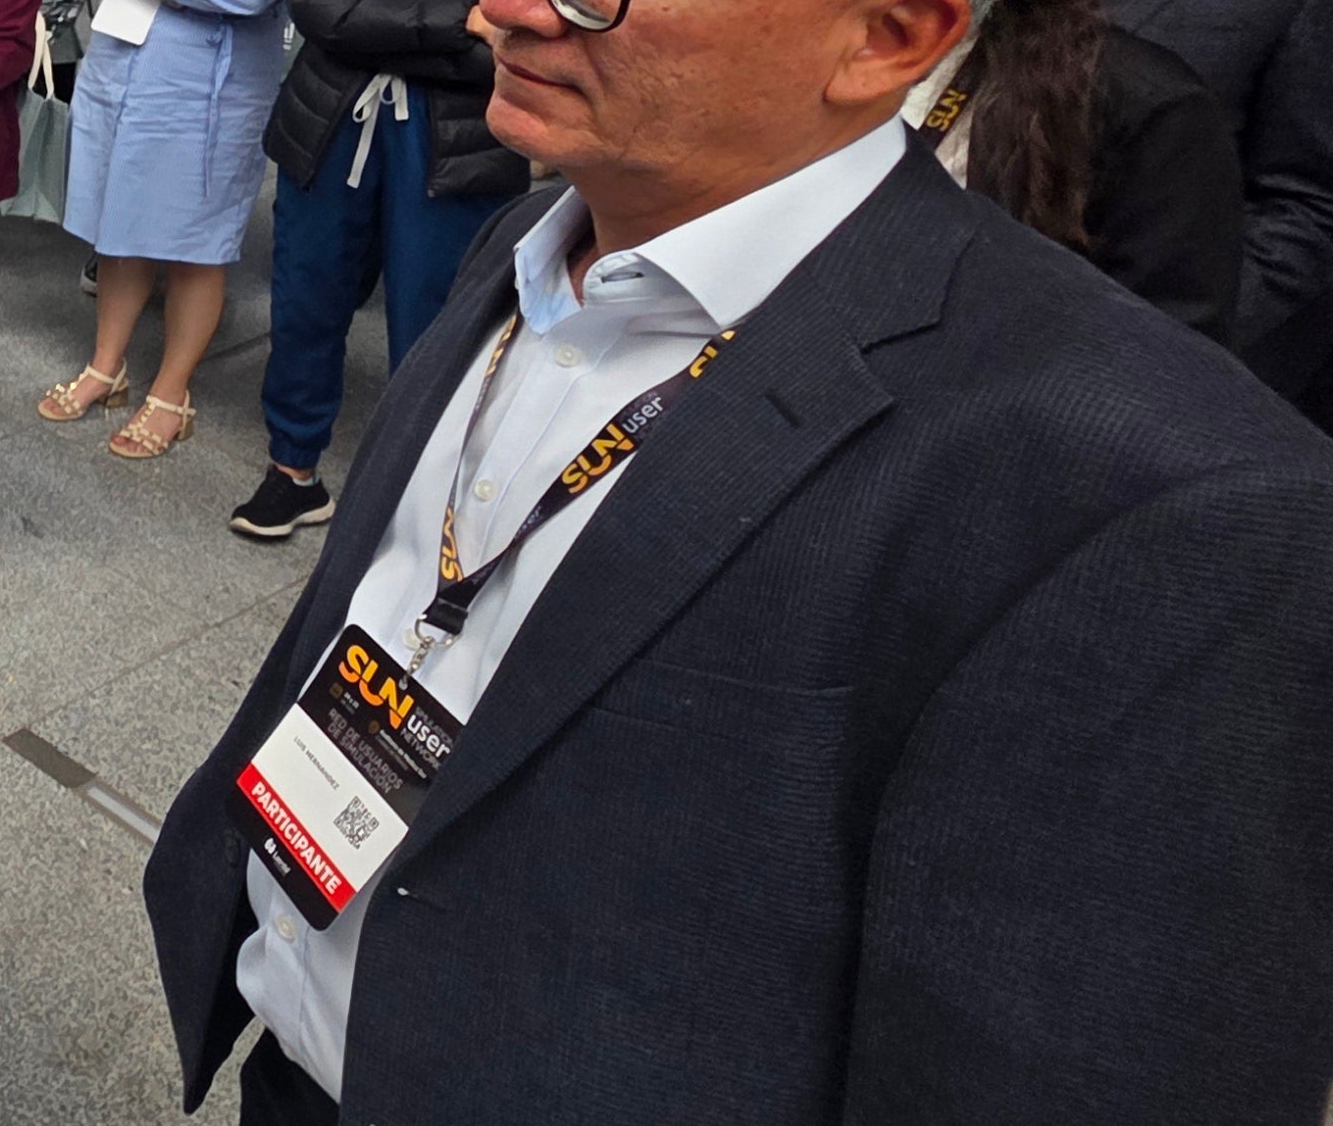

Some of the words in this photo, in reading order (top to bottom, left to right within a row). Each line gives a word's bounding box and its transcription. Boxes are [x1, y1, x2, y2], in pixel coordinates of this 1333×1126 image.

[561, 423, 635, 494] SUN
[623, 395, 665, 435] user
[327, 723, 342, 744] DE
[328, 708, 347, 731] RED
[344, 724, 361, 745] DE
[338, 644, 415, 730] SUN
[407, 714, 451, 759] user
[250, 781, 343, 895] PARTICIPANTE
